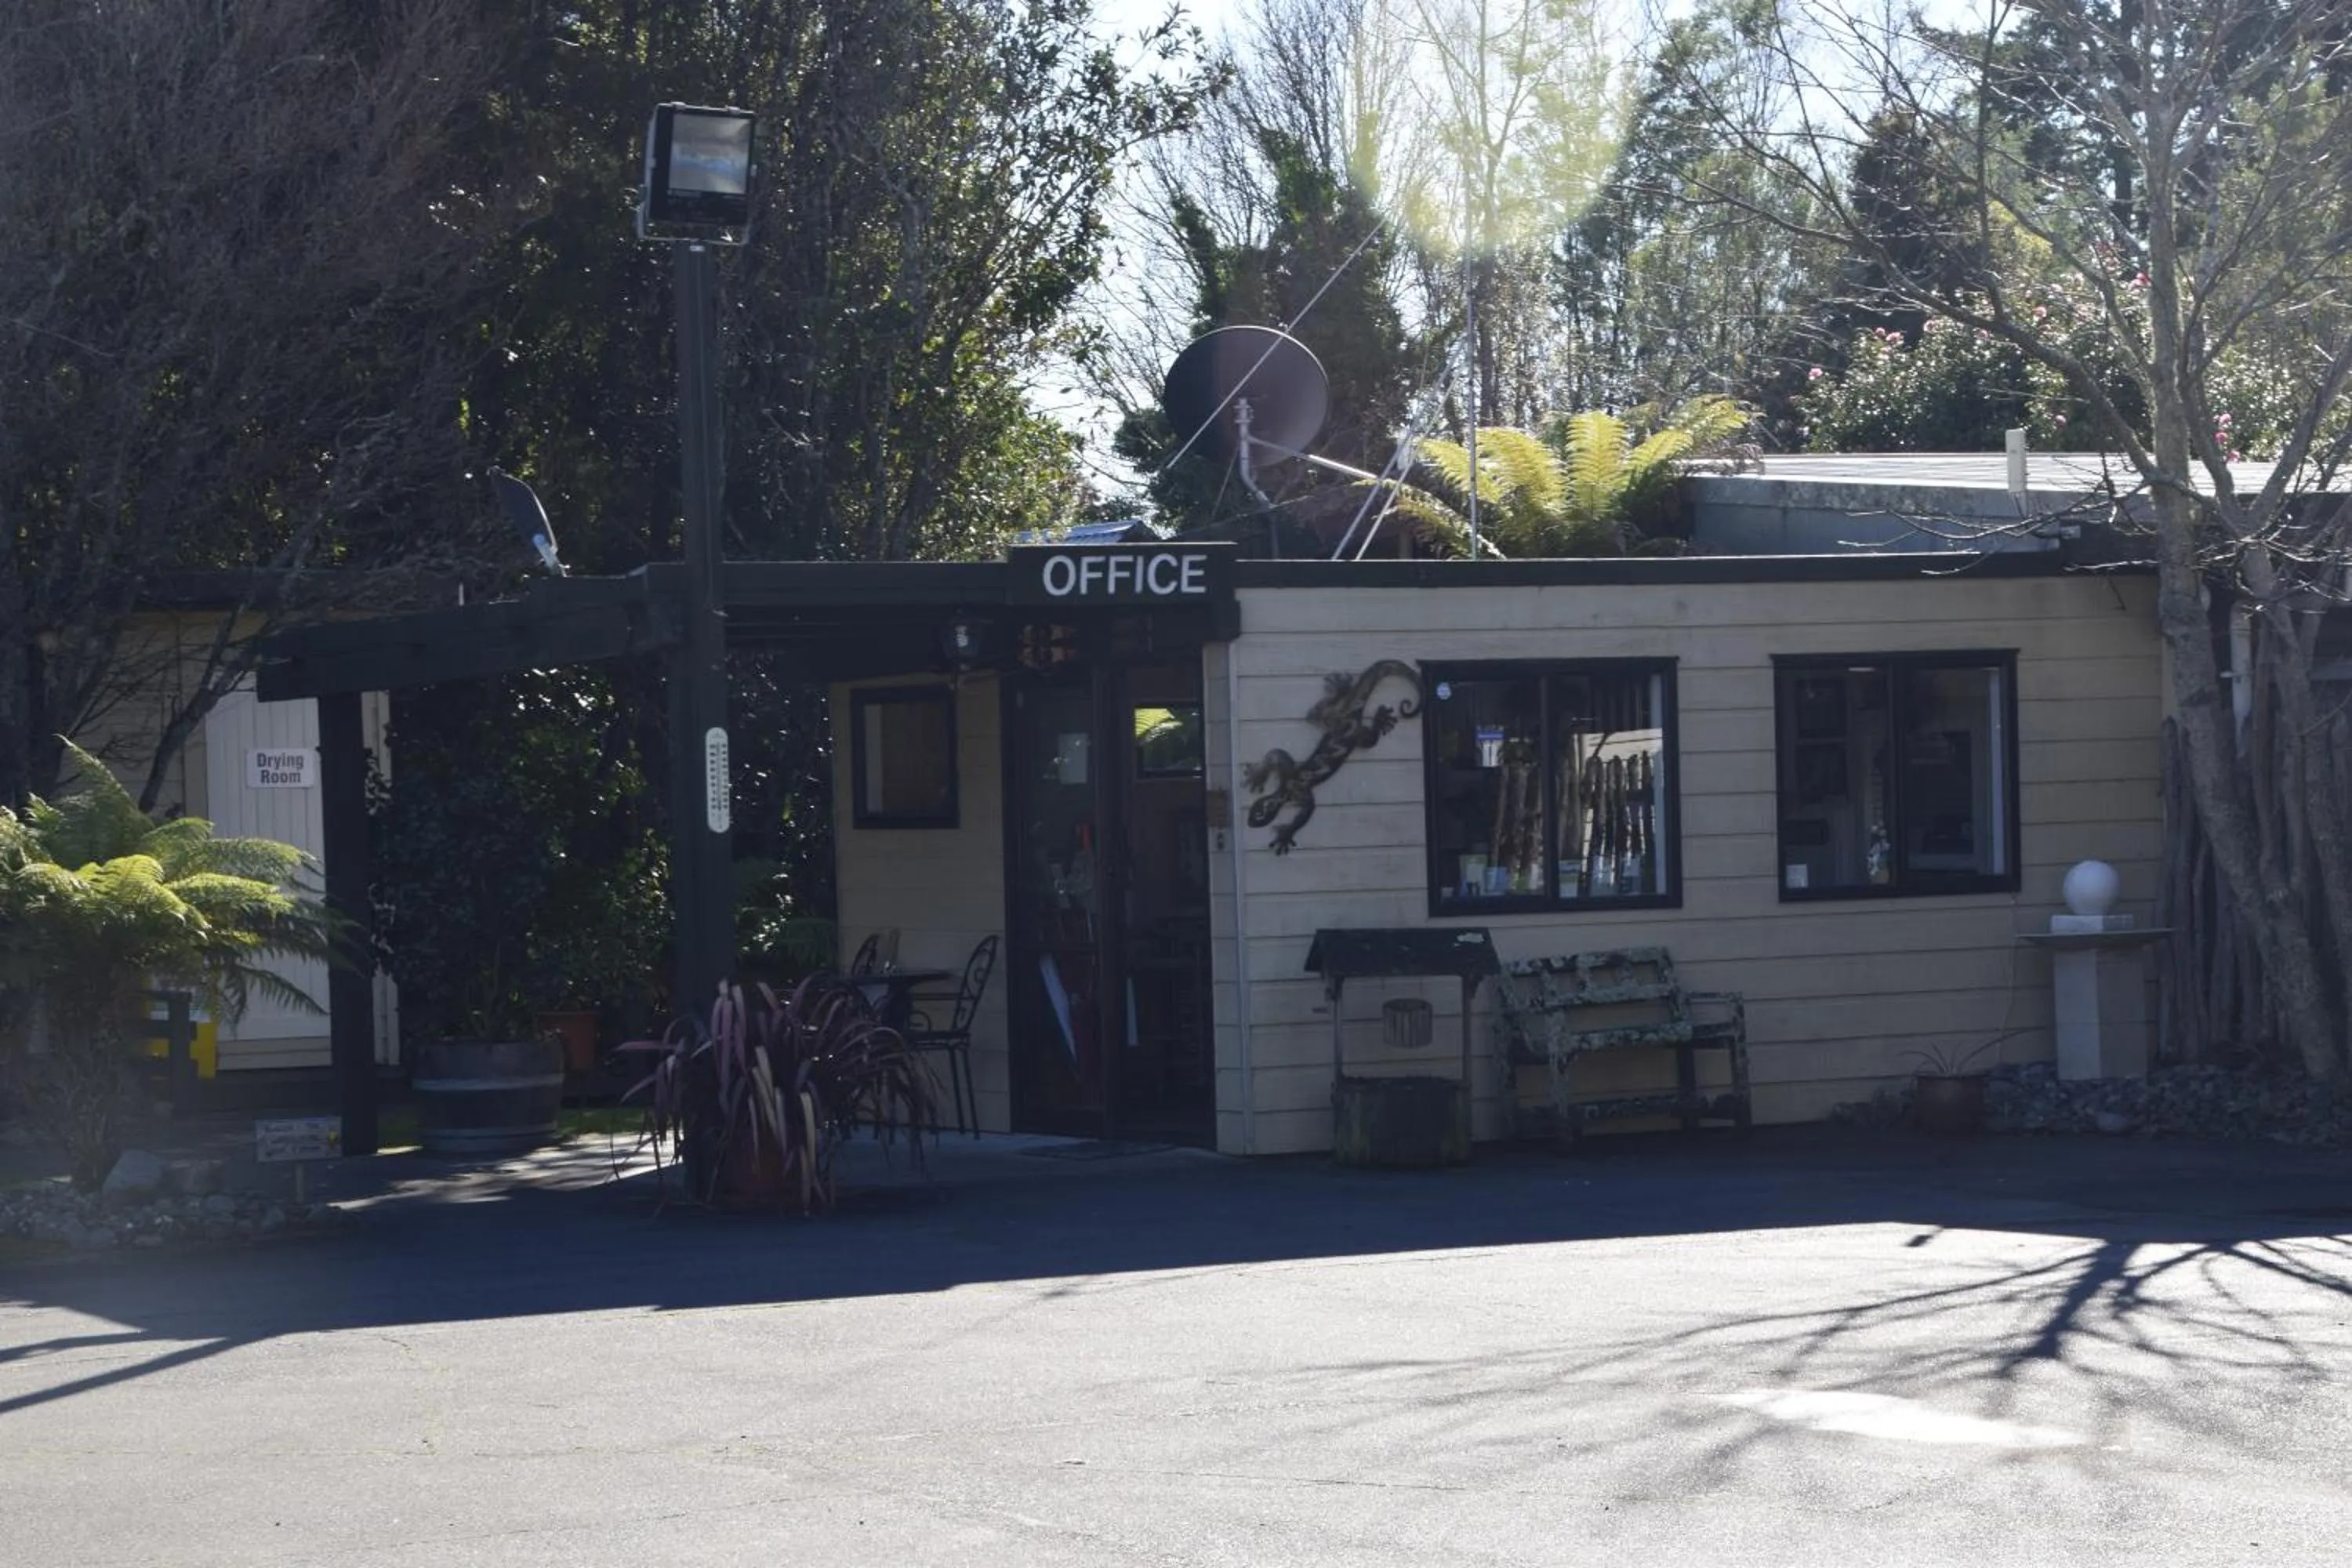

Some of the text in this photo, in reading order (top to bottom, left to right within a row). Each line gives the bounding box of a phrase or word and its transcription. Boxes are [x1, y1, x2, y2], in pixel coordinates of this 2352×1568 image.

[1042, 554, 1207, 596] OFFICE
[256, 753, 304, 769] Drying
[261, 769, 301, 784] Room
